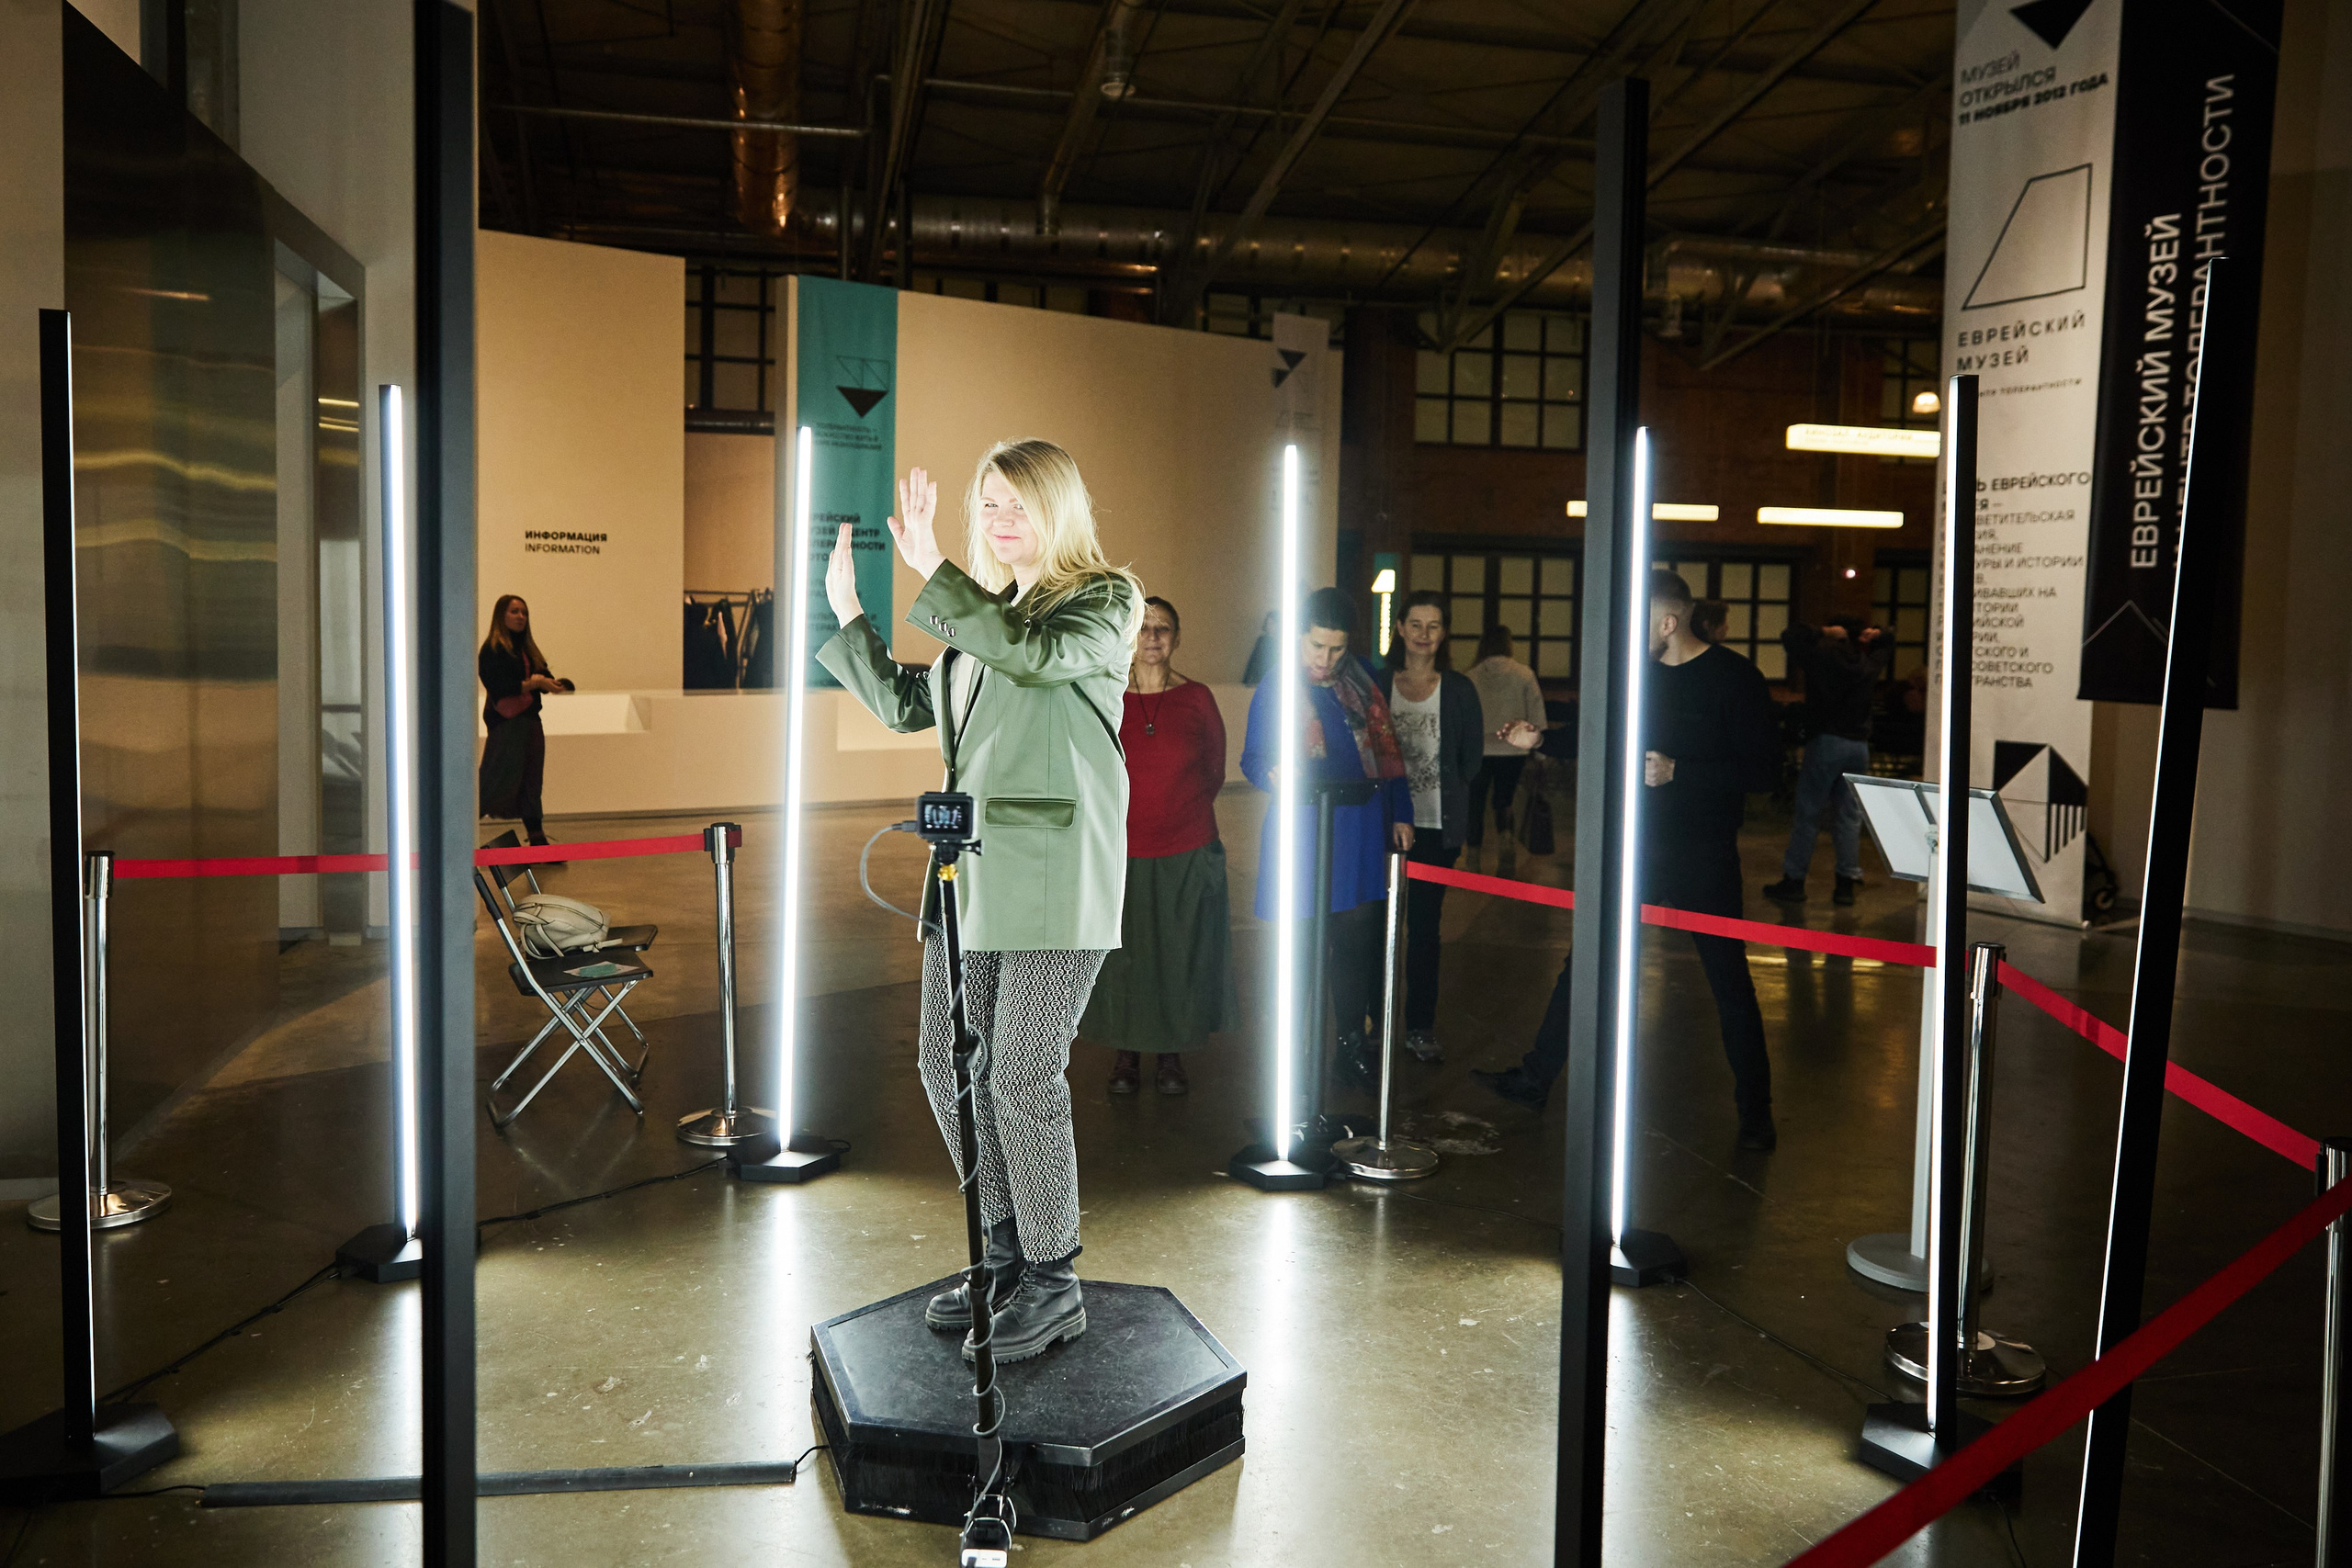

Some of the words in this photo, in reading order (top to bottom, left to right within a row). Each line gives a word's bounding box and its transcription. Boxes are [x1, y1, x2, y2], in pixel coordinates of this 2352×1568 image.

[1961, 51, 2020, 84] МУЗЕЙ
[1960, 66, 2056, 107] ОТКРЫЛСЯ
[2070, 73, 2109, 96] ГОДА
[2144, 213, 2182, 342] МУЗЕЙ
[1958, 310, 2086, 347] ЕВРЕЙСКИЙ
[1957, 345, 2029, 371] МУЗЕЙ
[2130, 350, 2172, 568] ЕВРЕЙСКИЙ
[1991, 471, 2091, 491] ЕВРЕЙСКОГО
[1941, 510, 2075, 526] ВЕТИТЕЛЬСКАЯ
[525, 531, 607, 542] ИНФОРМАЦИЯ
[525, 544, 600, 554] INFORMATION
[2017, 555, 2084, 568] ИСТОРИИ
[2038, 587, 2057, 598] НА
